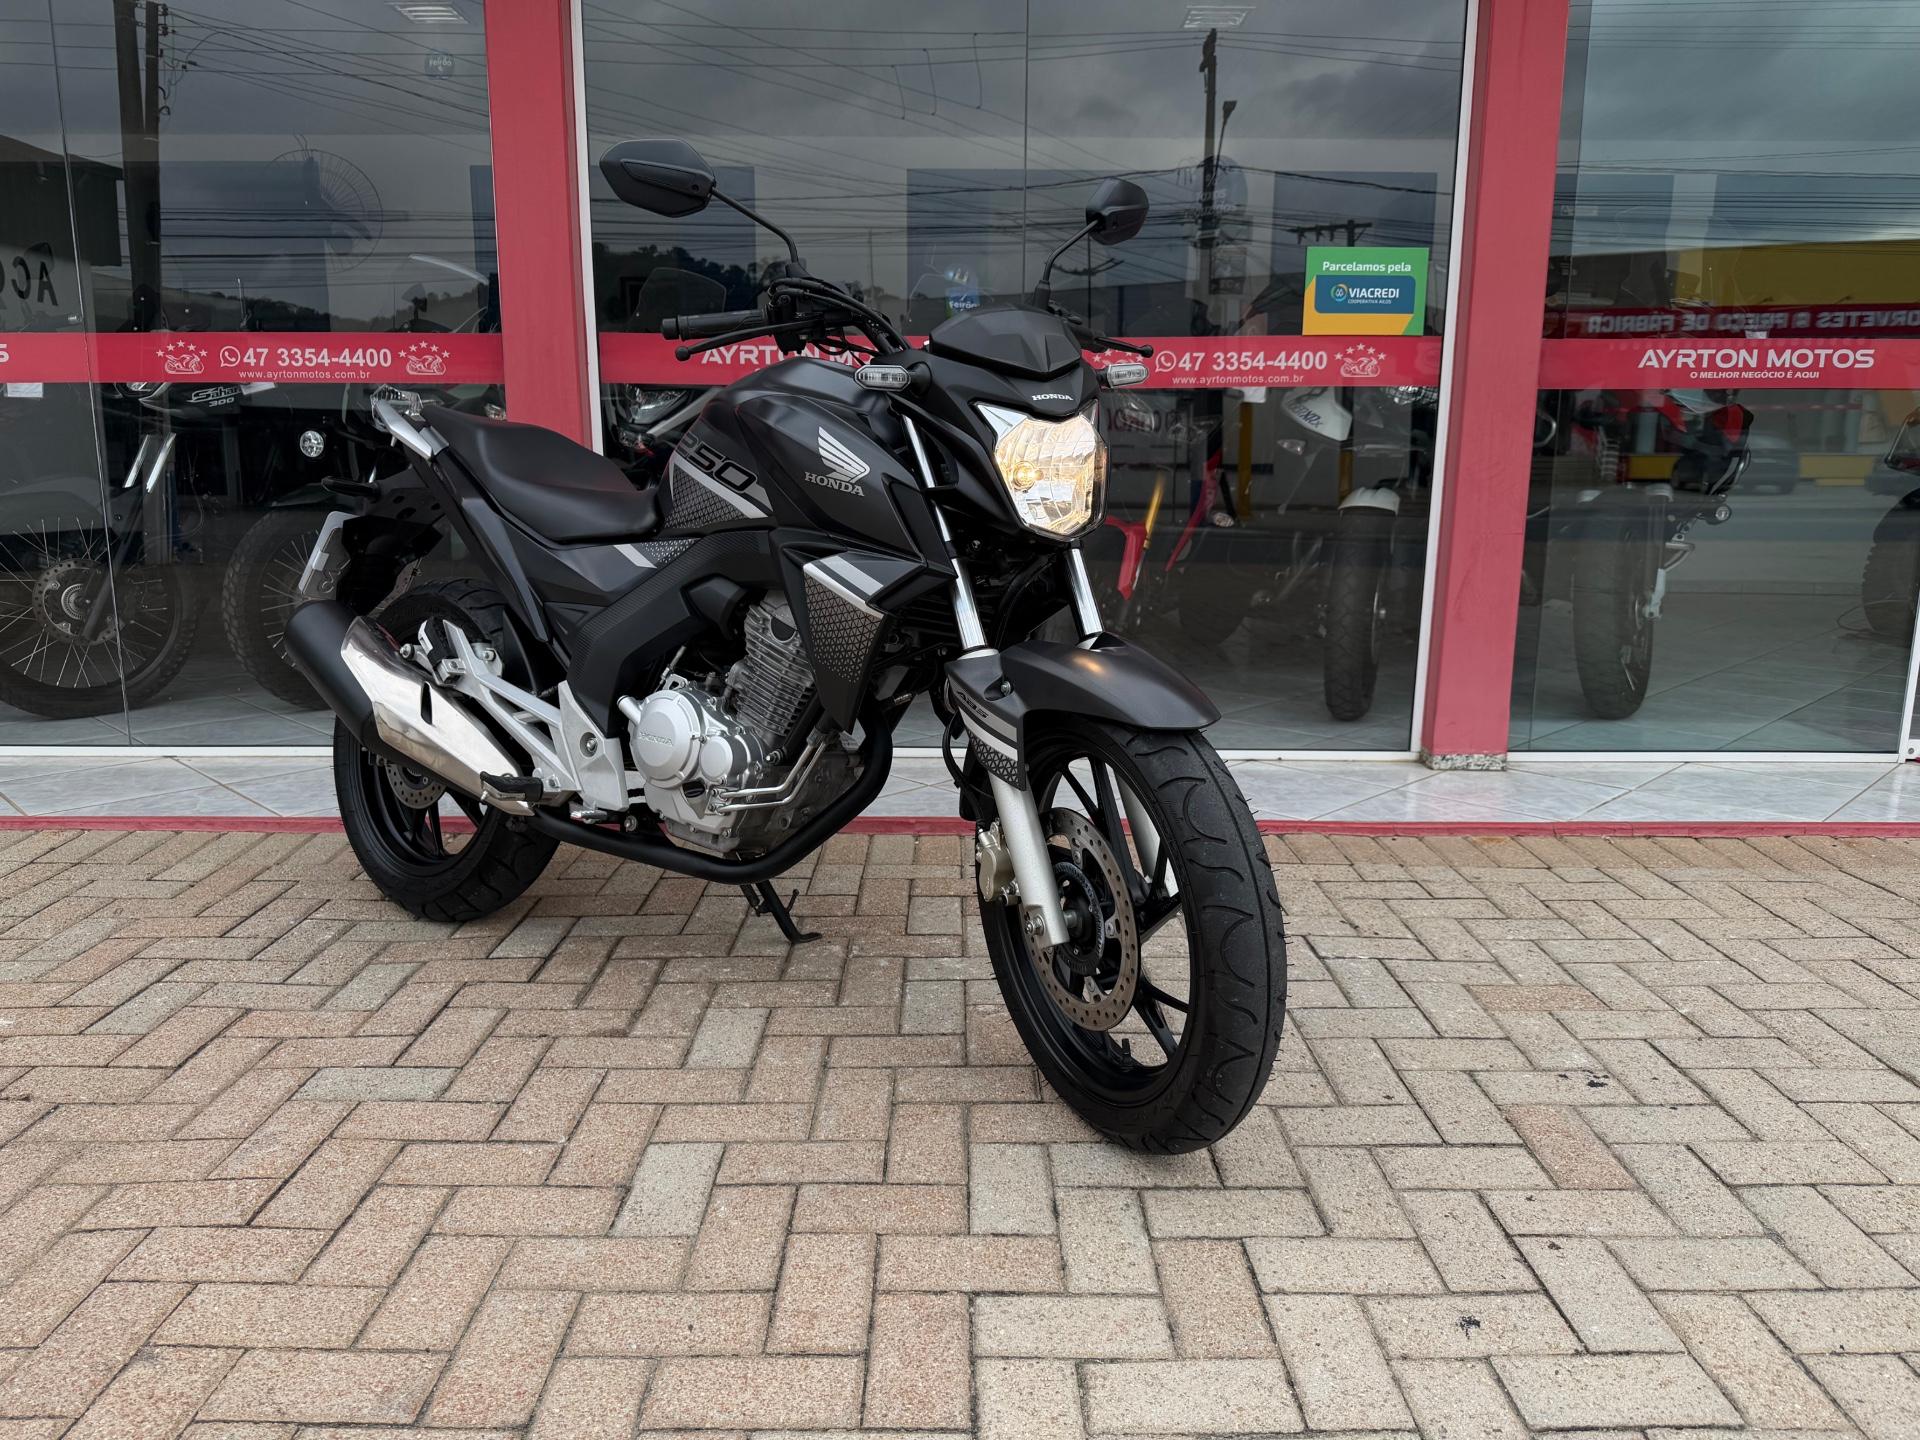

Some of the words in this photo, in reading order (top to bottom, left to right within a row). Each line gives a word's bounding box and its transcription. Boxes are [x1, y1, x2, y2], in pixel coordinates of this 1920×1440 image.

[1322, 262, 1386, 272] Parcelamos
[1387, 262, 1412, 274] pela
[1349, 288, 1400, 298] VIACREDI
[243, 348, 269, 367] 47
[277, 348, 392, 367] 3354-4400
[701, 345, 819, 365] AYRTN
[1178, 352, 1205, 371] 47
[1212, 351, 1328, 371] 3354-4400
[1638, 349, 1758, 369] AYRTON
[1766, 349, 1875, 369] MOTOS
[239, 370, 371, 381] www.ayrtonmotos.com.br
[1172, 374, 1304, 386] www.ayrtonmotos.com.br
[1689, 371, 1698, 379] O
[1699, 371, 1739, 379] MELHOR
[1741, 370, 1785, 379] NEGÓCIO
[1786, 369, 1793, 379] É
[1794, 371, 1820, 379] AQUI
[208, 397, 235, 407] 300
[1031, 393, 1074, 401] HONDA
[804, 471, 865, 497] HONDA
[639, 731, 673, 747] HONDA
